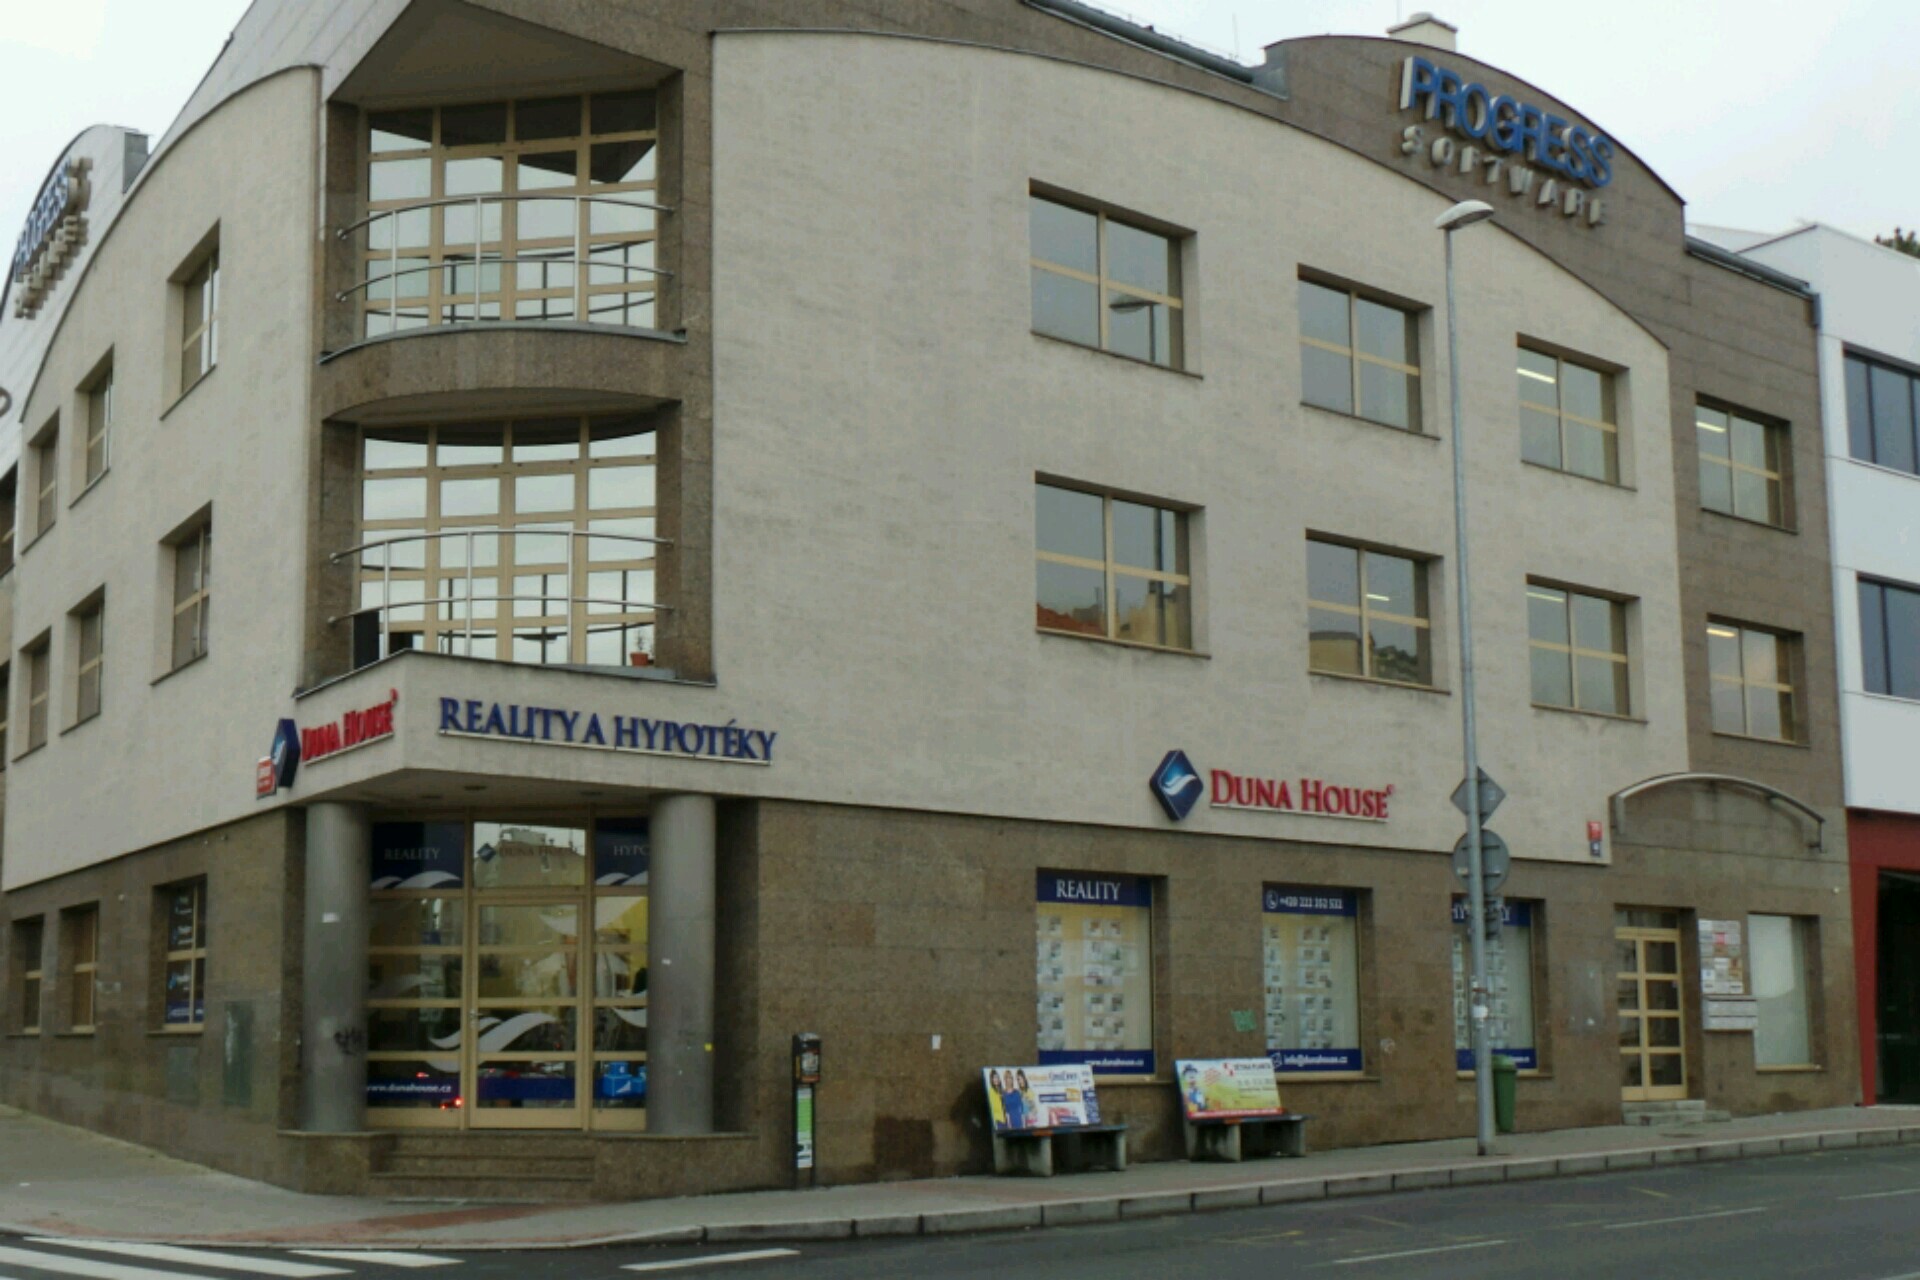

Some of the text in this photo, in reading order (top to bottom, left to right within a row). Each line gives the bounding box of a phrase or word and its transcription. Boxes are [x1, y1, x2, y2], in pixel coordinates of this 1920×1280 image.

[1400, 55, 1614, 188] PROGRESS
[1401, 124, 1606, 226] SOFTWARE
[439, 697, 778, 761] REALITY A HYPOTÉKY
[1210, 768, 1389, 819] DUNA HOUSE
[384, 847, 440, 860] REALITY
[1055, 879, 1122, 901] REALITY
